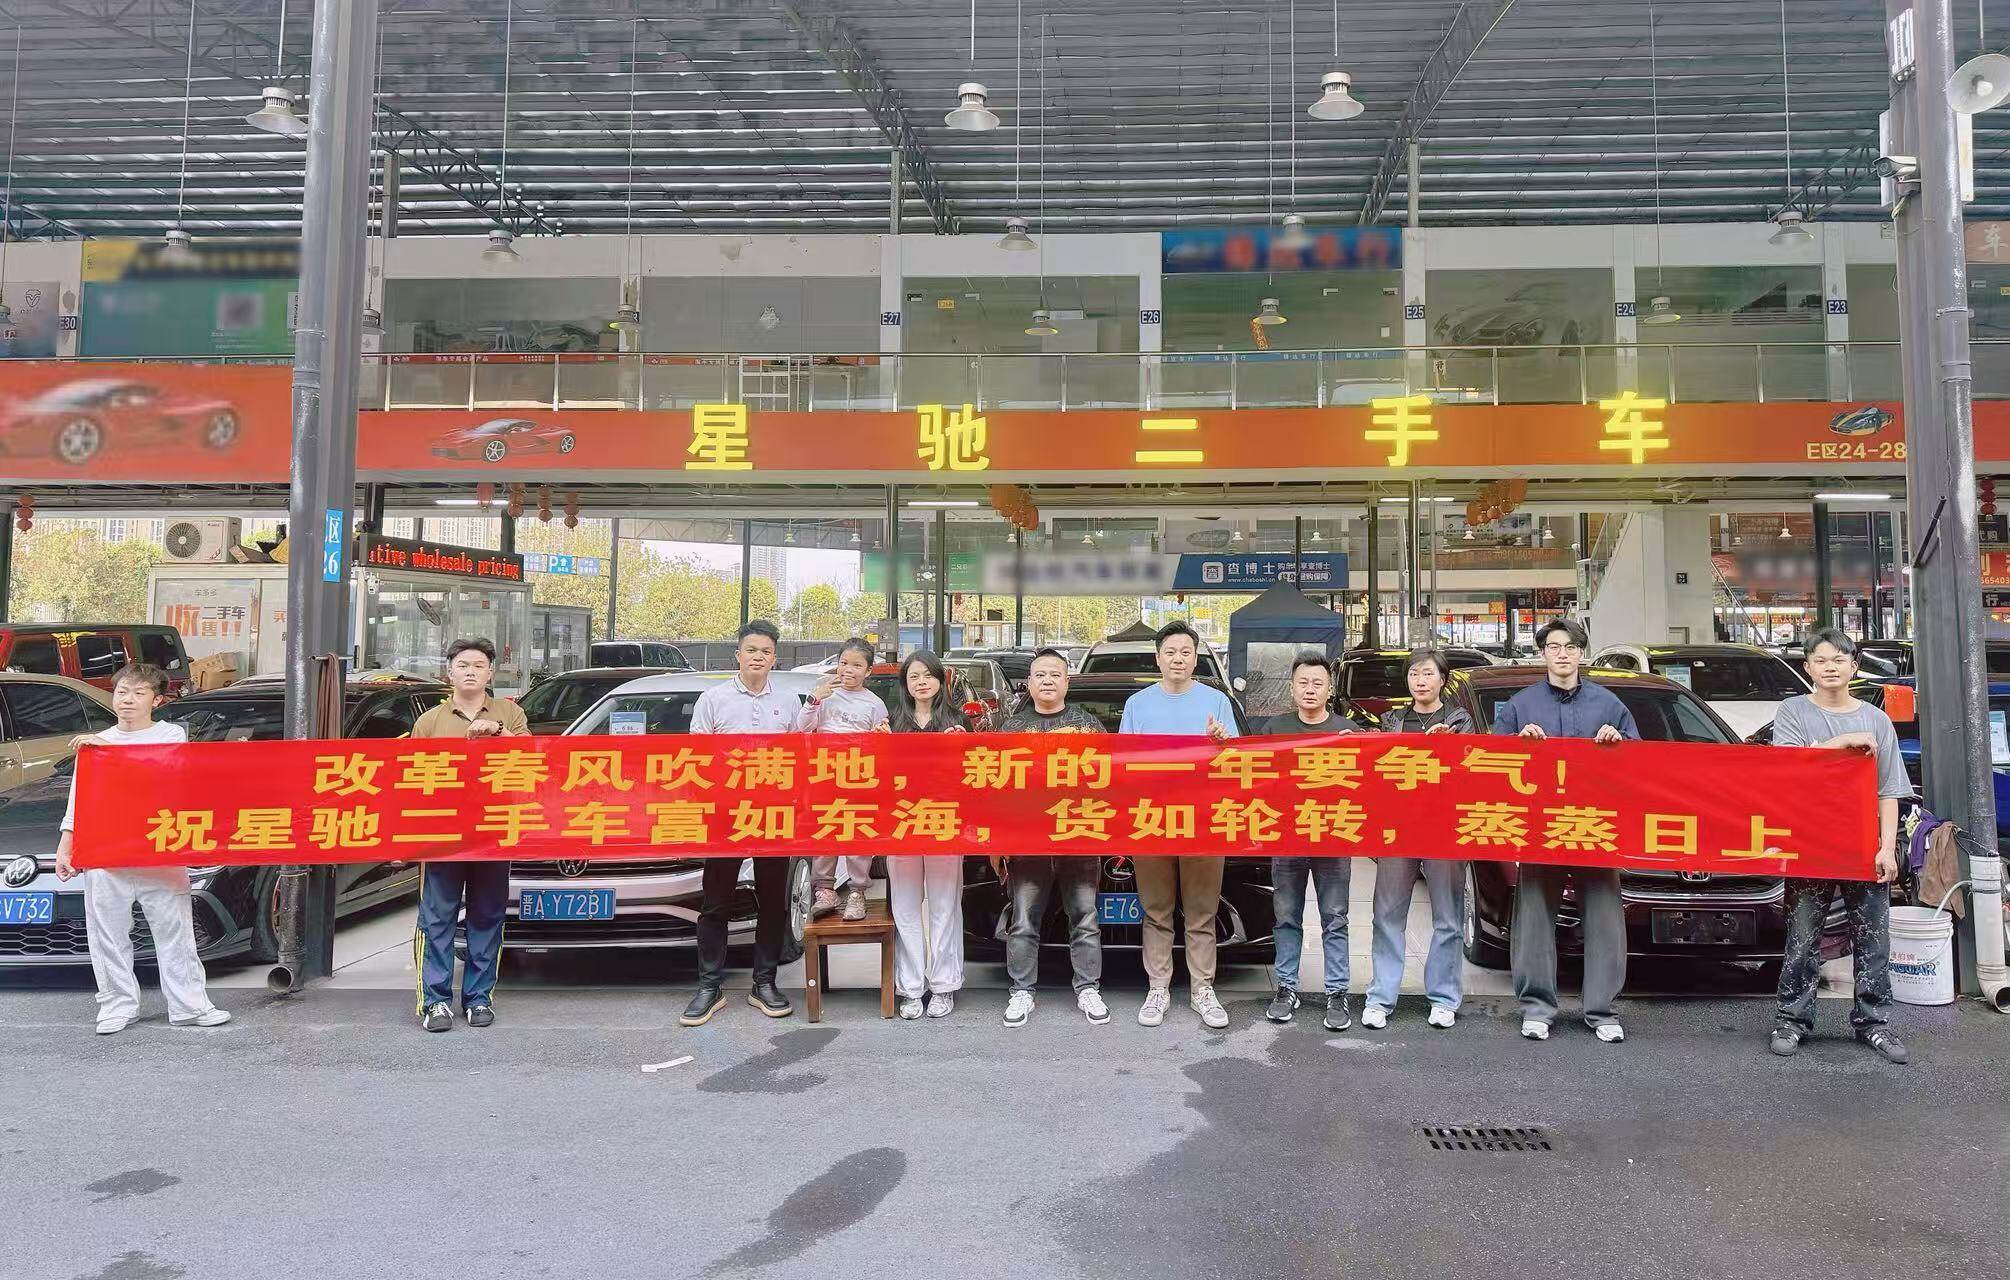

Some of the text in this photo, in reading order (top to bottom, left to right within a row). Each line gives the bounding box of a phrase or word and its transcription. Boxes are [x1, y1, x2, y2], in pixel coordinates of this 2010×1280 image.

[1406, 305, 1424, 319] E25
[1616, 303, 1635, 316] E24
[1828, 301, 1847, 314] E23
[882, 313, 899, 325] E27
[1141, 311, 1160, 324] E26
[687, 391, 1669, 471] 星驰二手车
[1807, 442, 1906, 459] E区24-28
[412, 547, 473, 573] wholesale
[477, 556, 519, 579] pricing
[1228, 562, 1275, 575] 查博士
[202, 606, 246, 620] 二手车
